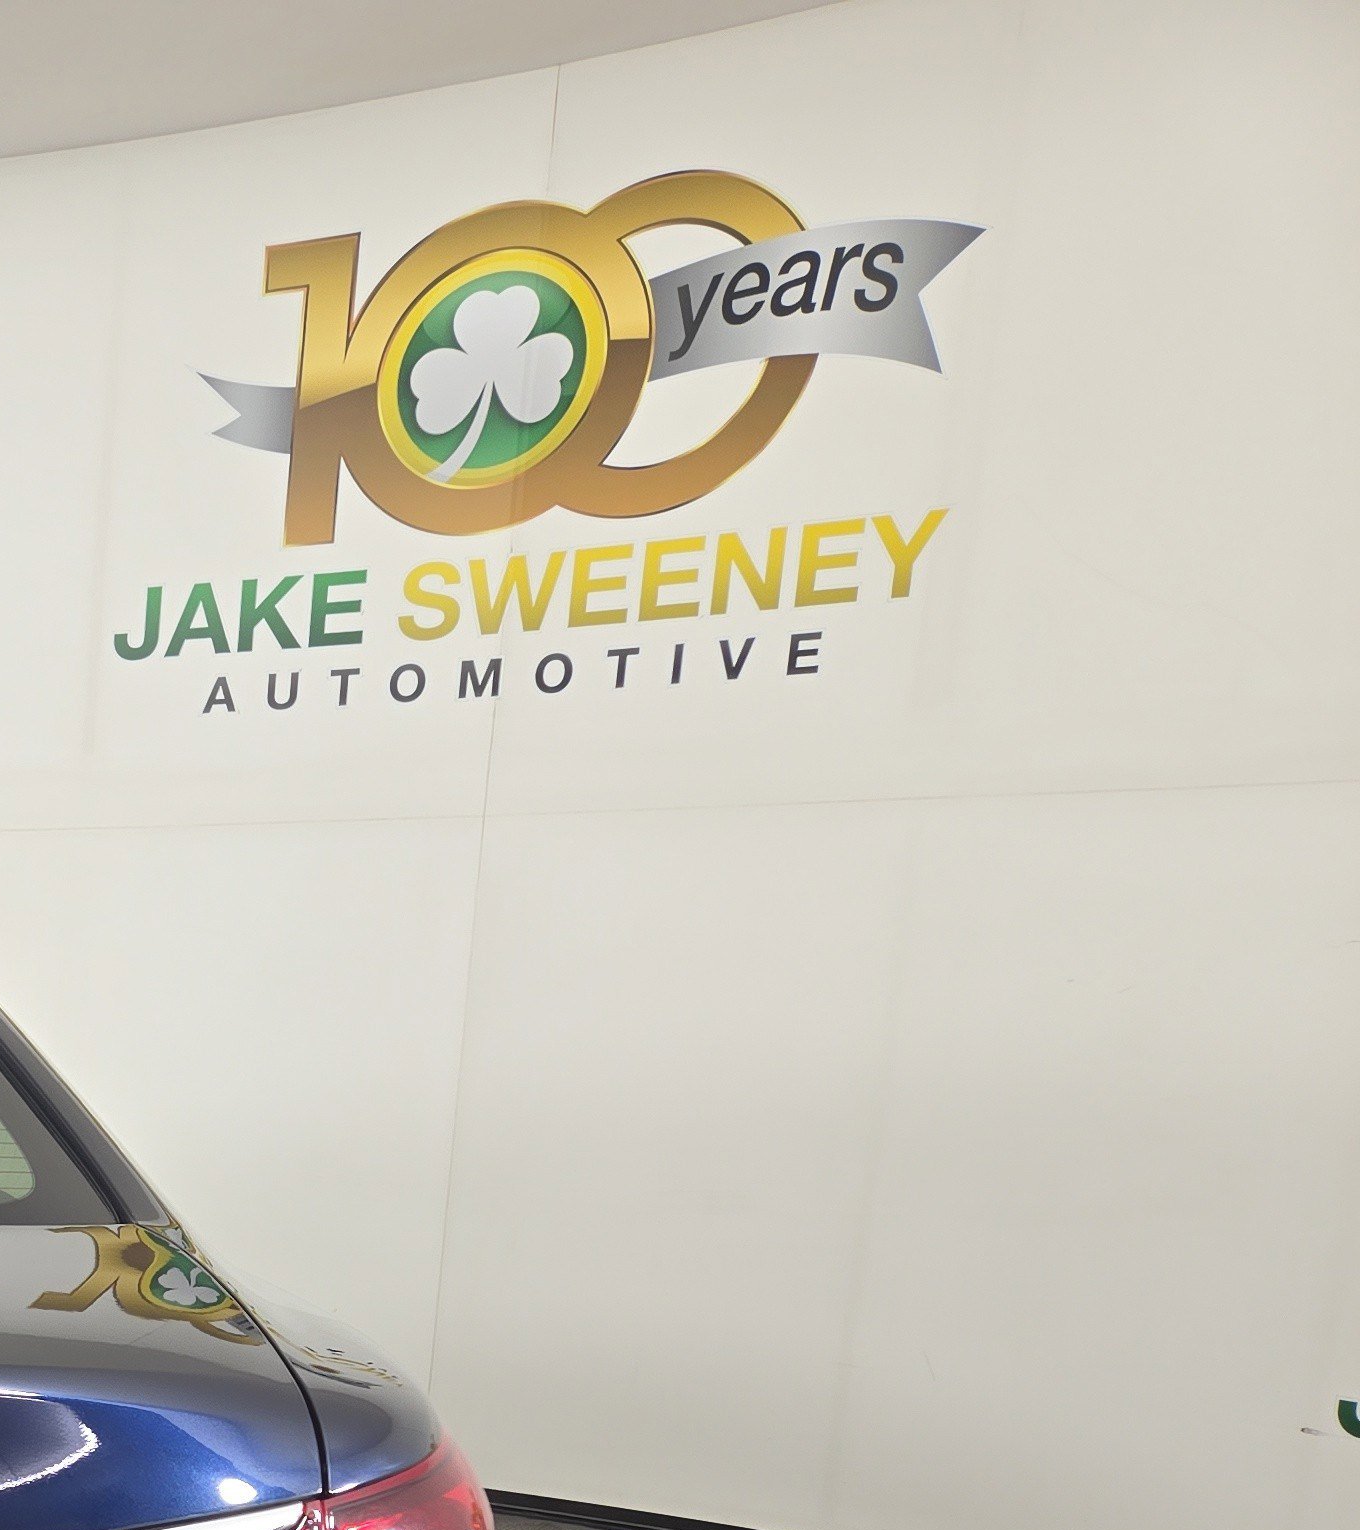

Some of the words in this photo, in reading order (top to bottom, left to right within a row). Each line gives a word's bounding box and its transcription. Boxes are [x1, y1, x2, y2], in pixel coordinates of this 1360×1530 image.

[263, 168, 818, 547] 100
[668, 240, 904, 361] years
[113, 568, 367, 660] JAKE
[398, 508, 949, 642] SWEENEY
[202, 631, 824, 714] AUTOMOTIVE
